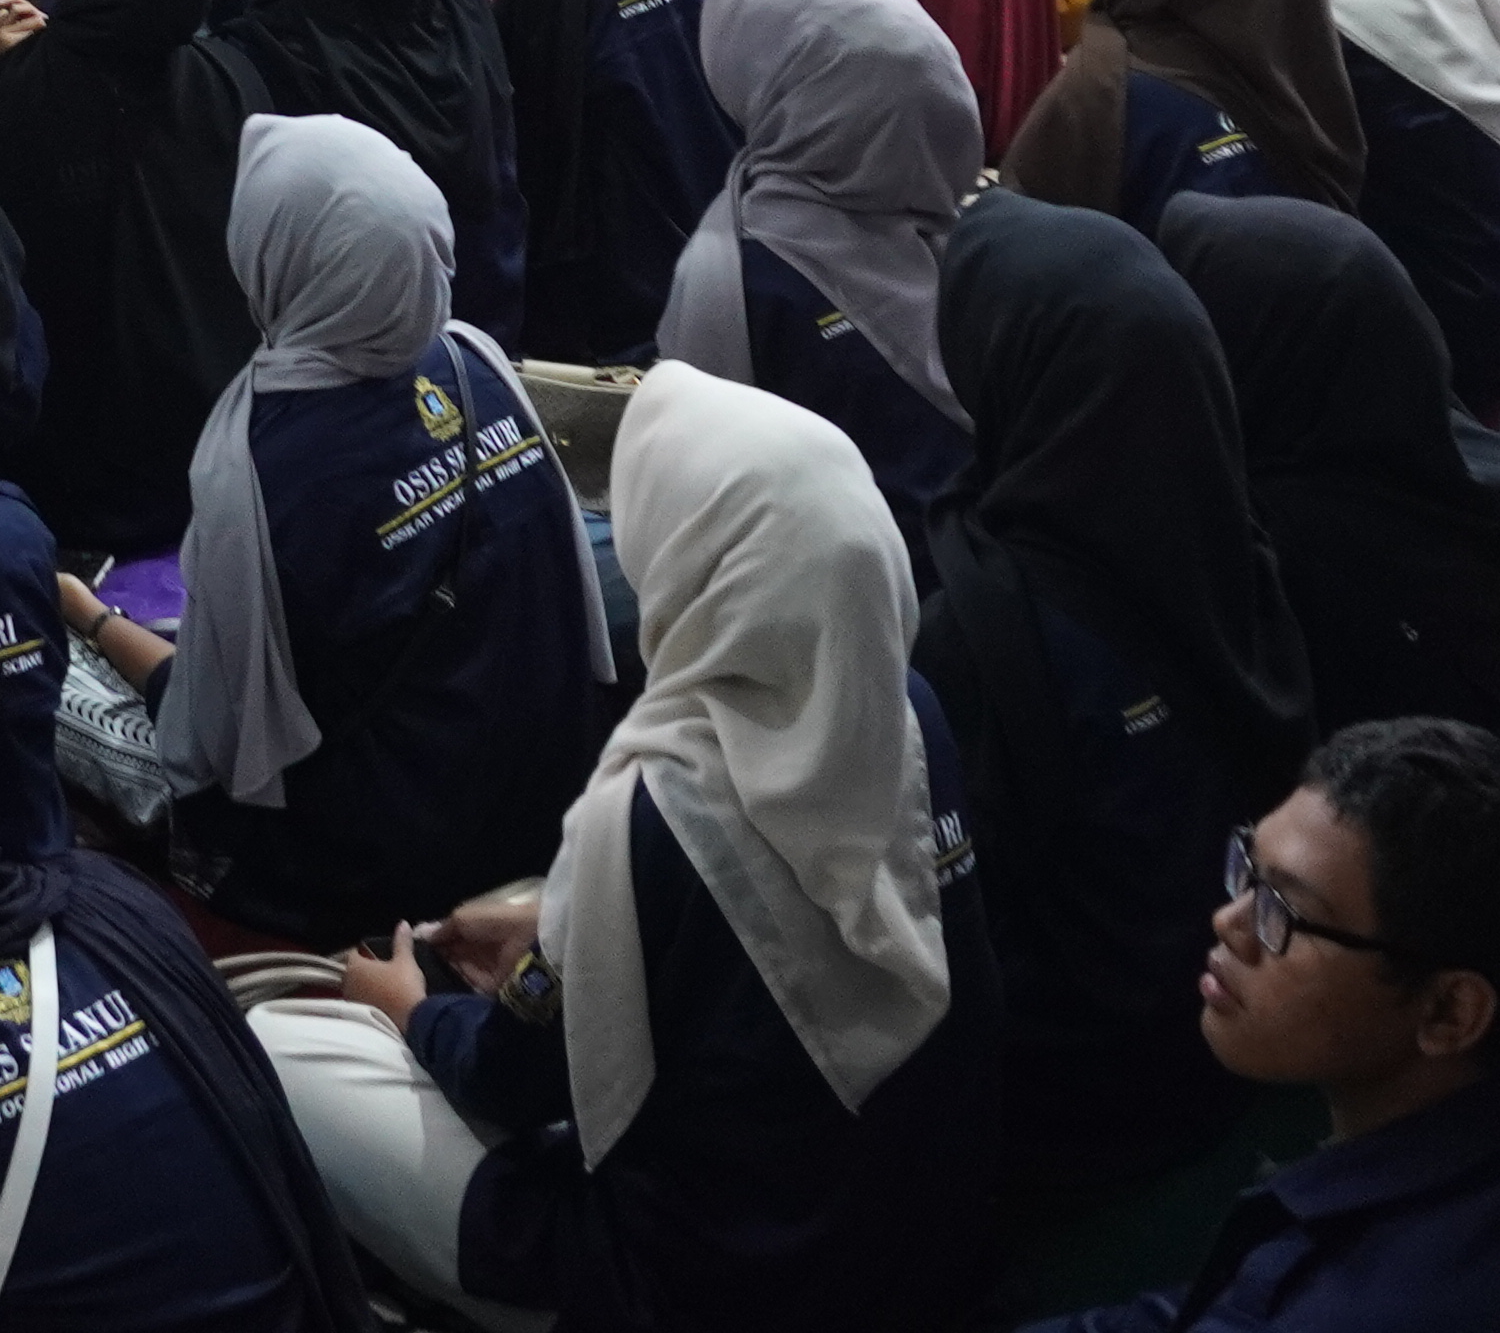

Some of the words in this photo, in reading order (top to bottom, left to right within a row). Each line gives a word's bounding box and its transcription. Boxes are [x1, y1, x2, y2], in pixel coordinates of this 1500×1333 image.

[393, 457, 450, 507] OSIS
[381, 510, 436, 551] OSSKAN
[102, 1035, 150, 1070] HIGH
